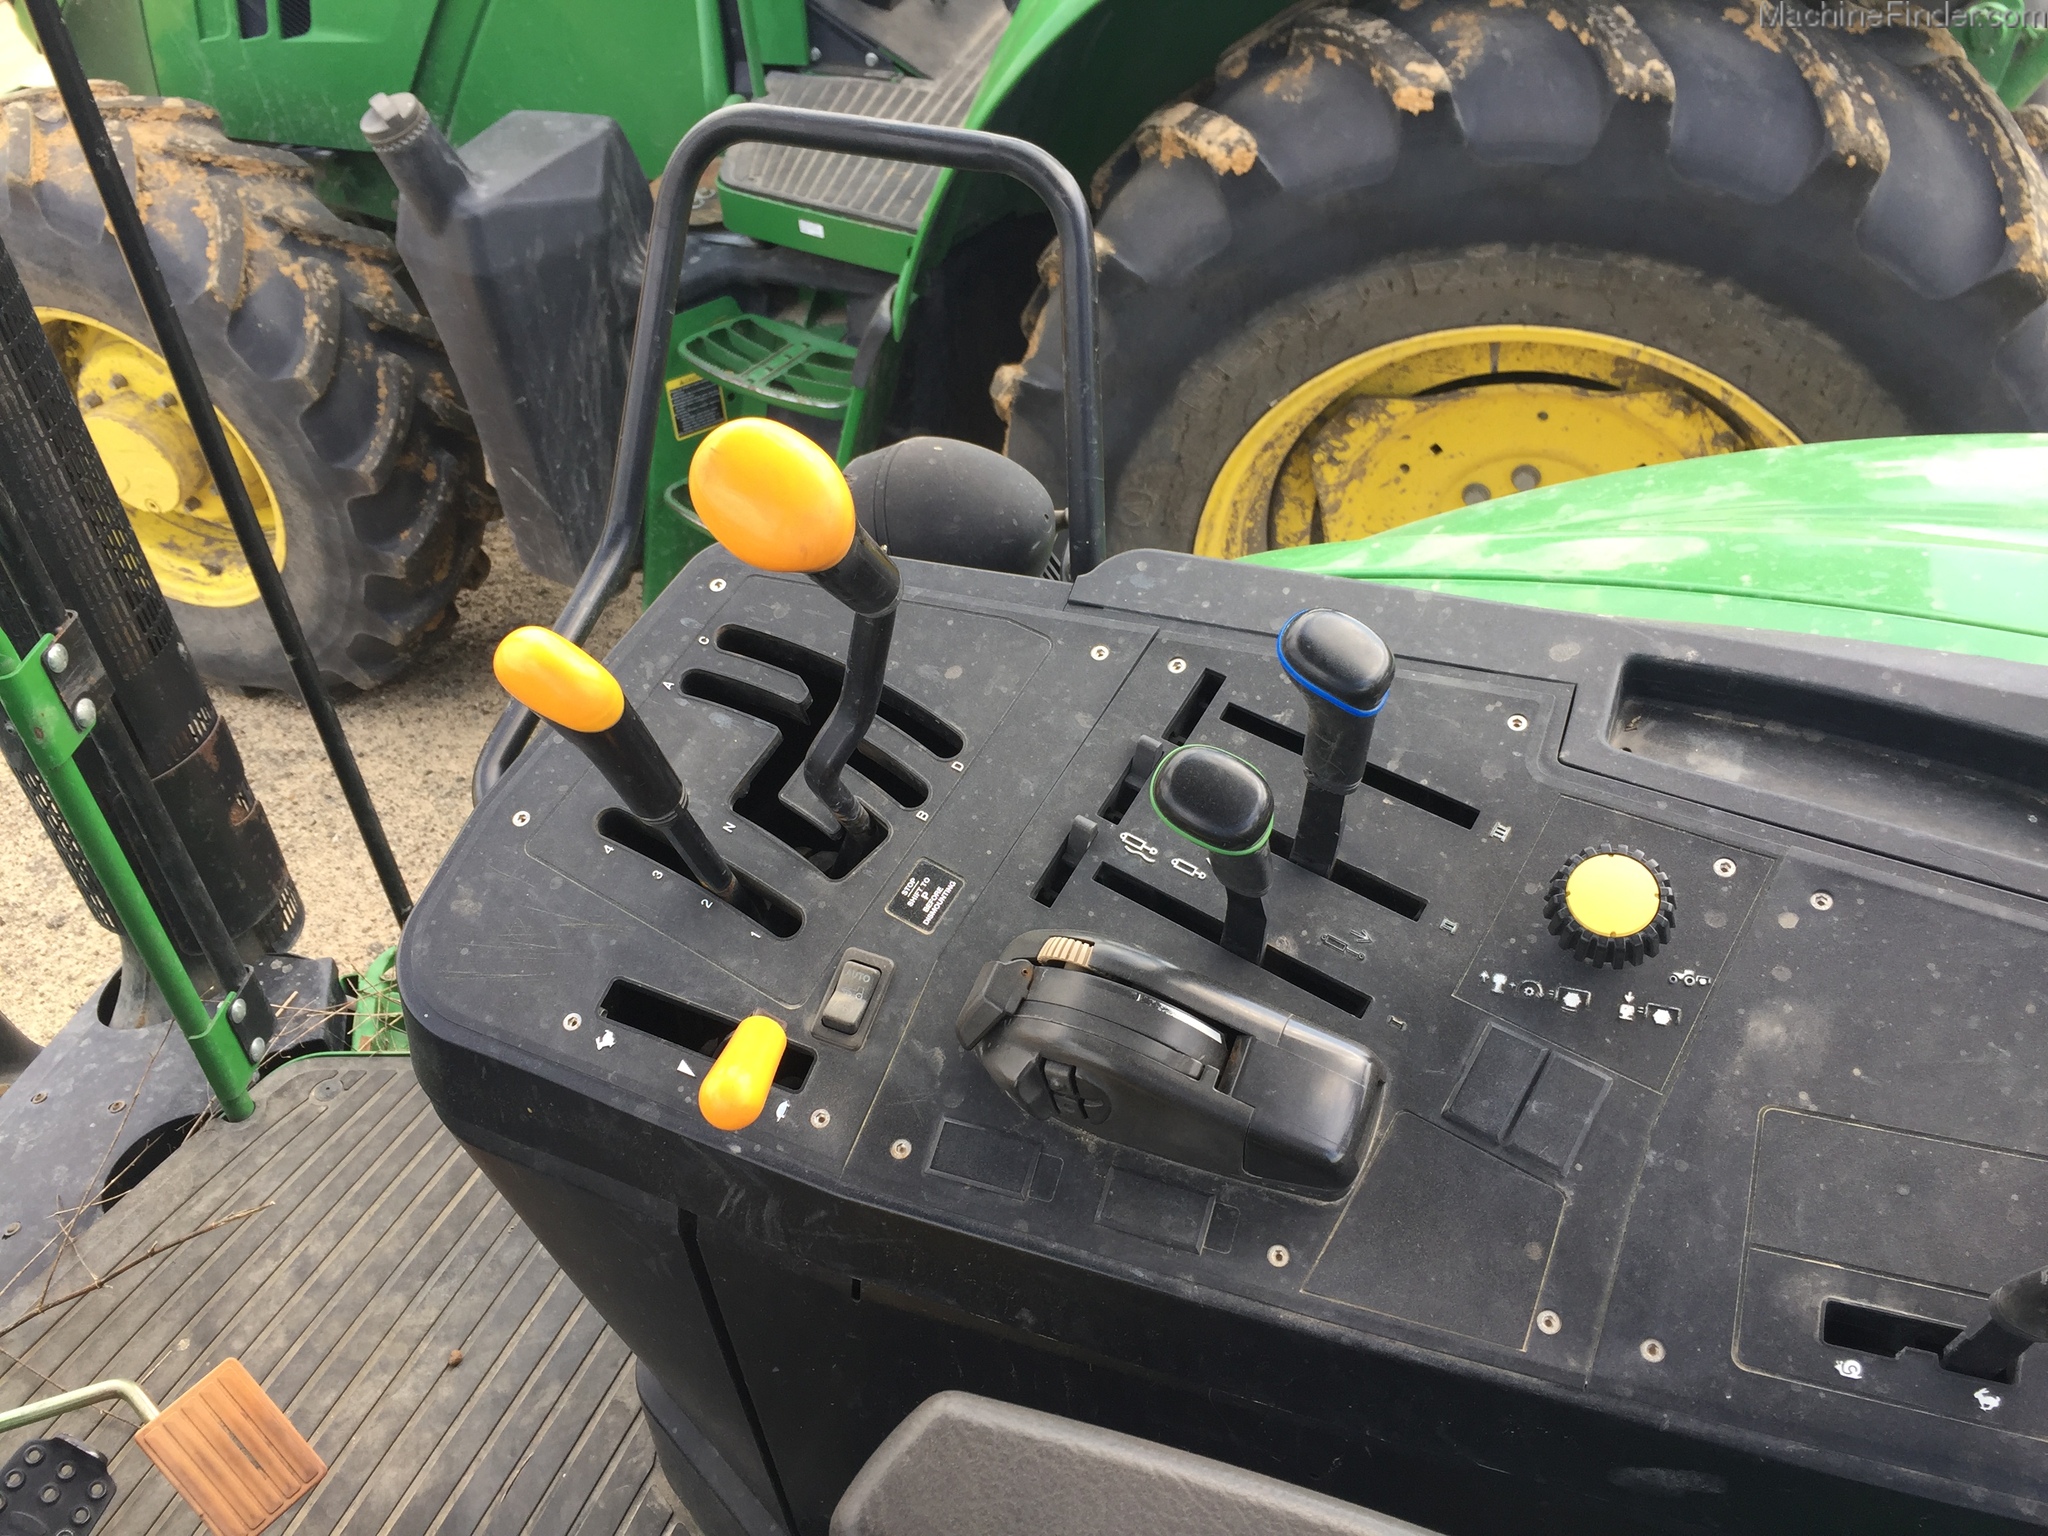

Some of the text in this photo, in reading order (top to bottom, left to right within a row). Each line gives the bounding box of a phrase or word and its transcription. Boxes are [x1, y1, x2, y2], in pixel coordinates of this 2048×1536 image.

[698, 636, 710, 646] C
[662, 681, 675, 691] A
[951, 761, 964, 772] D
[916, 810, 929, 822] B
[603, 844, 615, 856] 4
[652, 869, 664, 880] 3
[901, 877, 916, 896] STOP
[906, 877, 930, 907] SHIFT TO
[921, 891, 930, 900] P
[922, 886, 944, 913] BEFORE
[700, 898, 713, 909] 2
[922, 880, 957, 926] DISMOUNTING
[750, 930, 762, 939] 1
[845, 970, 871, 983] AUTO
